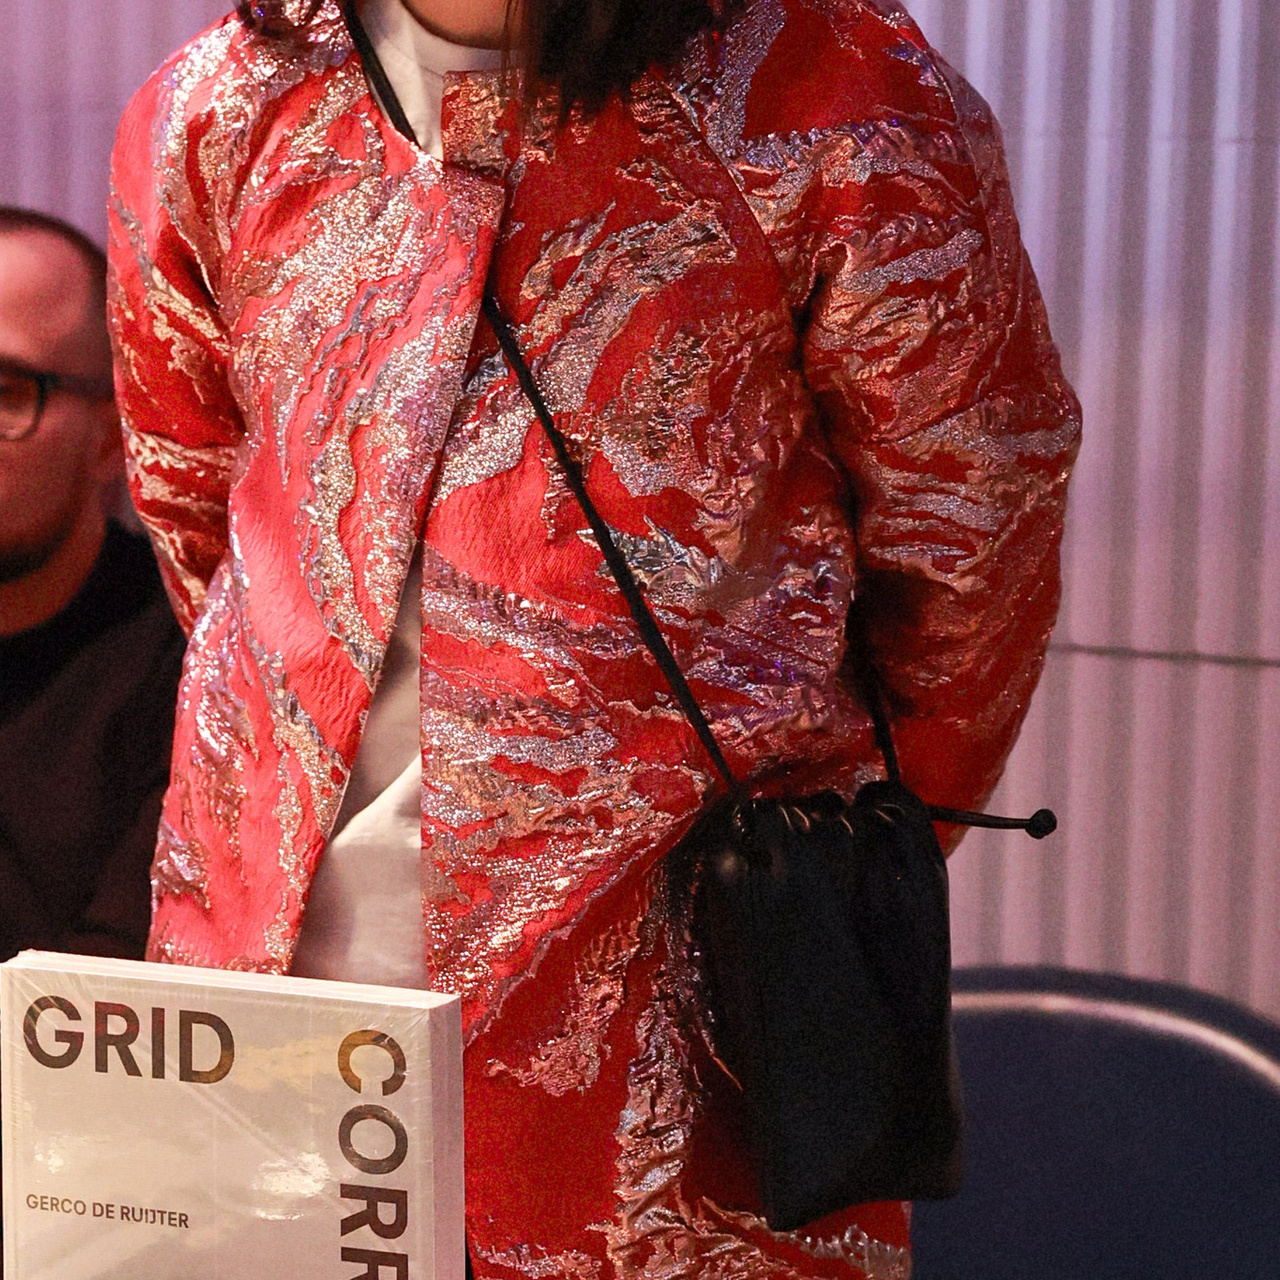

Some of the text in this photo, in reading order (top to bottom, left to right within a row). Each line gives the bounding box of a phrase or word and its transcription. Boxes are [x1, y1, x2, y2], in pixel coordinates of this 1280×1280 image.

[23, 995, 236, 1085] GRID
[26, 1193, 190, 1229] GERCO DE RUIJTER
